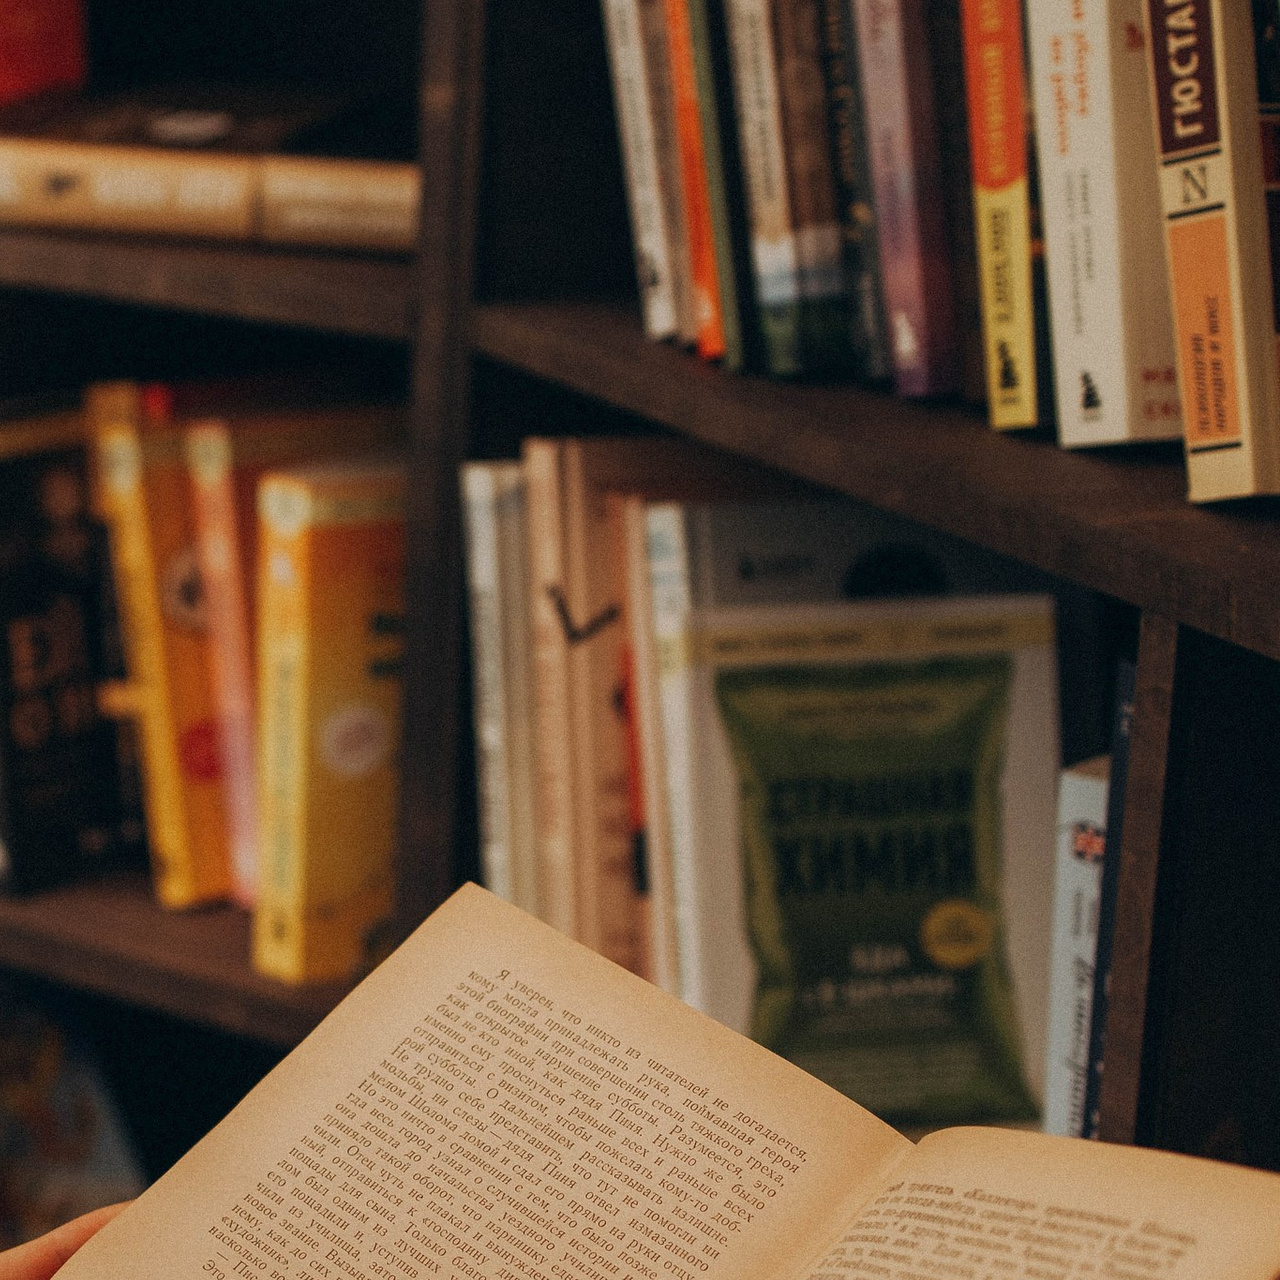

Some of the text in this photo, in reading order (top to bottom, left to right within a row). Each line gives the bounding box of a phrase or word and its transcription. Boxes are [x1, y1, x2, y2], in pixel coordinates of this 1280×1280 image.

[368, 1070, 606, 1227] мелом Шолома домой прямо
[400, 1110, 435, 1134] ничто
[449, 1142, 512, 1184] сравнении
[413, 1026, 708, 1212] отправиться визитом, чтобы пожелать кому-то
[413, 1062, 697, 1244] трудно представить, помогли
[423, 1014, 718, 1198] именно проснуться раньше раньше
[474, 1011, 743, 1179] открытое нарушение субботы. Разумеется,
[486, 999, 784, 1187] биографии совершении столь тяжкого греха,
[544, 1018, 799, 1173] принадлежать поймавшая героя
[585, 1024, 807, 1162] никто читателей догадается,
[651, 1133, 696, 1166] Нужно
[243, 1193, 277, 1220] новое
[278, 1218, 319, 1252] звание.
[288, 1147, 336, 1181] пощады
[404, 1221, 446, 1256] Только
[290, 1187, 349, 1230] пощадили
[368, 1242, 418, 1278] уступив
[305, 1218, 360, 1261] училища,
[322, 1113, 371, 1147] приняло
[375, 1147, 411, 1172] такой
[412, 1172, 453, 1206] оборот,
[484, 1220, 548, 1264] парнишку
[331, 1156, 403, 1206] отправиться
[422, 1217, 489, 1264] «господину
[332, 1195, 369, 1223] одним
[393, 1238, 441, 1273] лучших
[360, 1121, 400, 1148] дошла
[427, 1163, 494, 1211] начальства
[497, 1211, 555, 1250] уездного
[398, 1126, 432, 1152] город
[432, 1150, 471, 1176] узнал
[486, 1184, 565, 1238] случившейся
[567, 1238, 619, 1274] истории
[426, 1200, 470, 1232] плакал
[452, 1106, 488, 1132] слезы
[584, 1191, 620, 1216] отвел
[628, 1218, 709, 1271] измазанного
[498, 1099, 575, 1149] дальнейшем
[578, 1150, 662, 1204] рассказывать
[671, 1205, 727, 1247] излишне.
[208, 1225, 267, 1269] насколько
[221, 1216, 288, 1270] «художник»,
